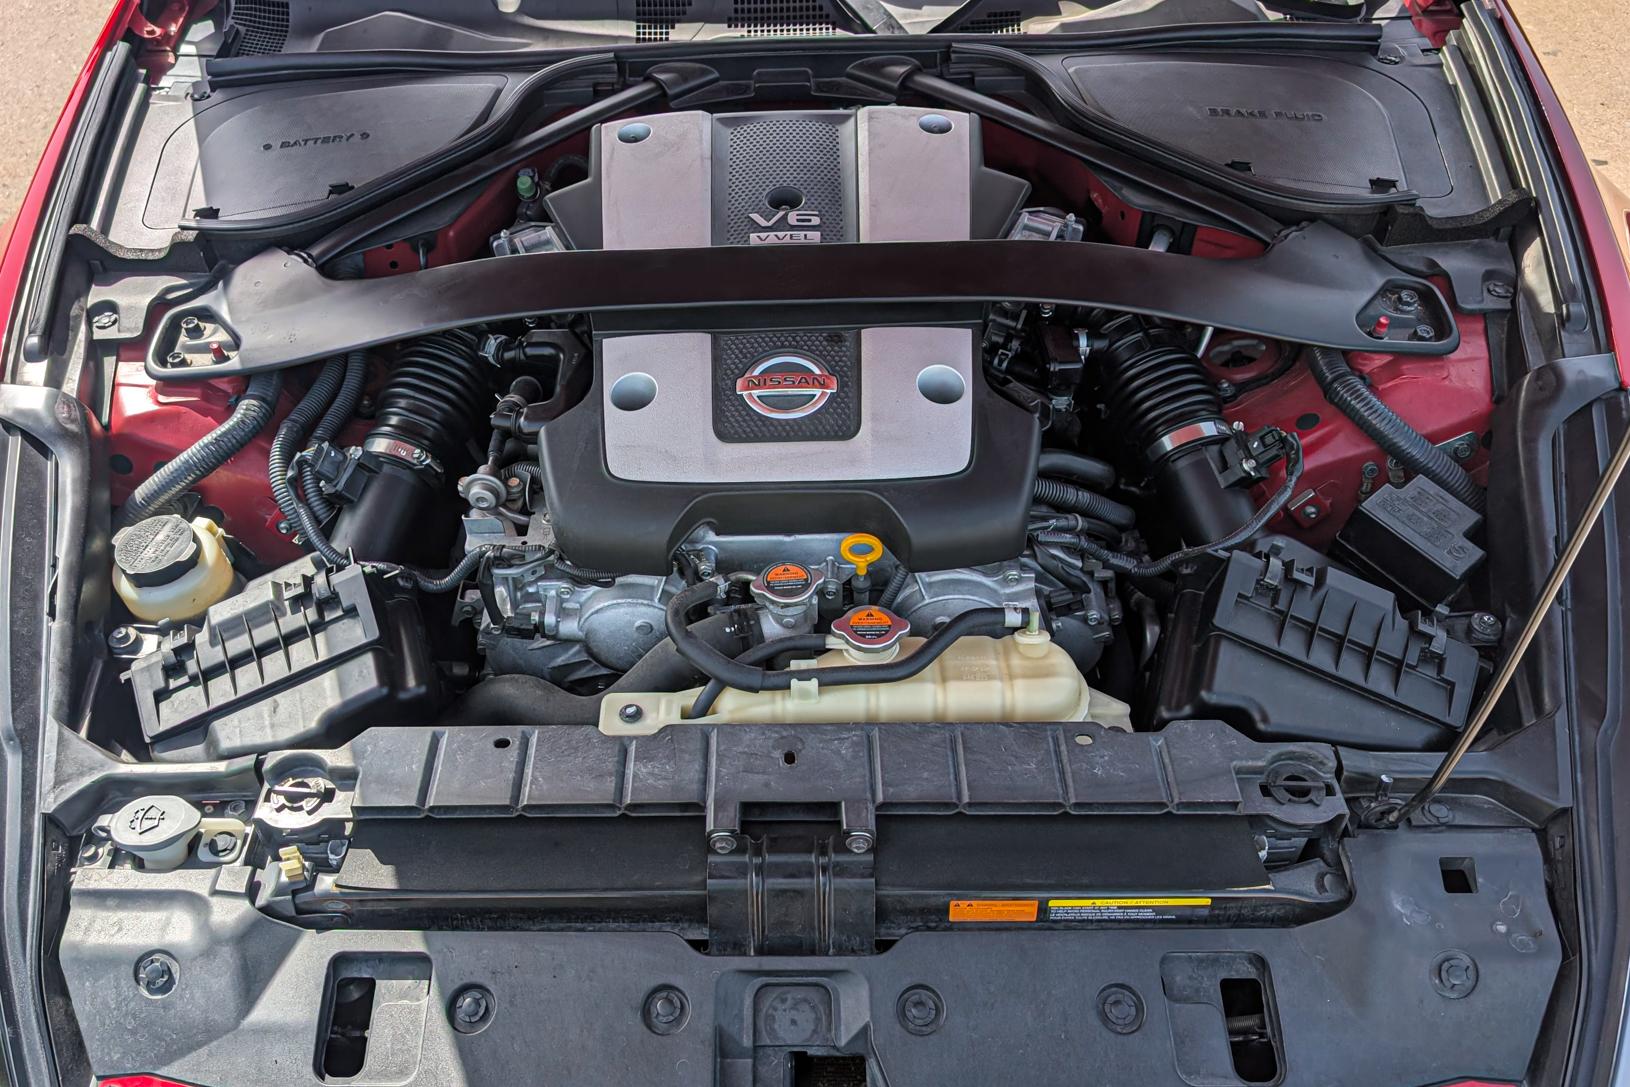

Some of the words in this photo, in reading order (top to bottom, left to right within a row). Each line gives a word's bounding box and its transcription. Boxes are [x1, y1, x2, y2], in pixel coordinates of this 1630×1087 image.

[1207, 107, 1268, 119] BRAKE
[1273, 110, 1325, 122] FLUID
[280, 133, 355, 149] BATTERY
[748, 210, 821, 227] V6
[747, 376, 826, 387] NISSAN
